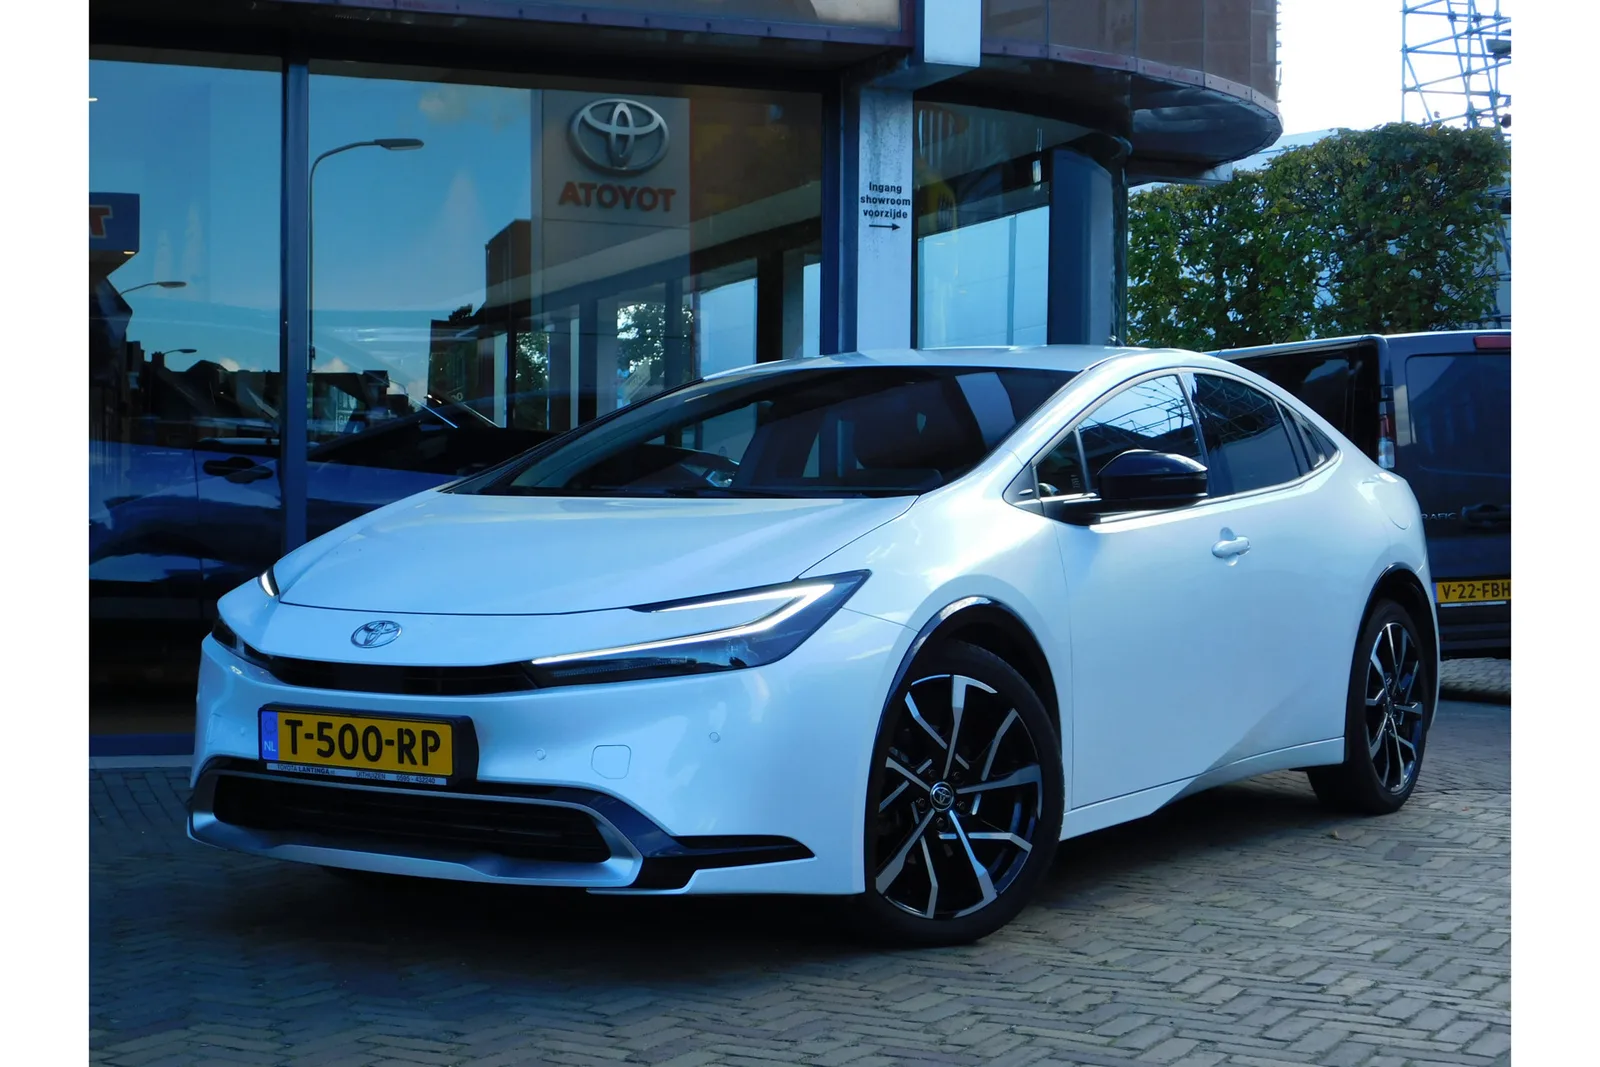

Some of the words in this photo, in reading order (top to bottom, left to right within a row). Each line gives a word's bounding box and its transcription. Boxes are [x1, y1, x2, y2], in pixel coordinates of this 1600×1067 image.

[869, 181, 902, 194] Ingang
[860, 195, 910, 206] showroom
[863, 209, 908, 219] voorzijde
[1442, 583, 1511, 600] V-22-FBH
[264, 740, 277, 752] NL
[285, 719, 441, 767] T-500-RP
[299, 766, 330, 774] LANTINGA
